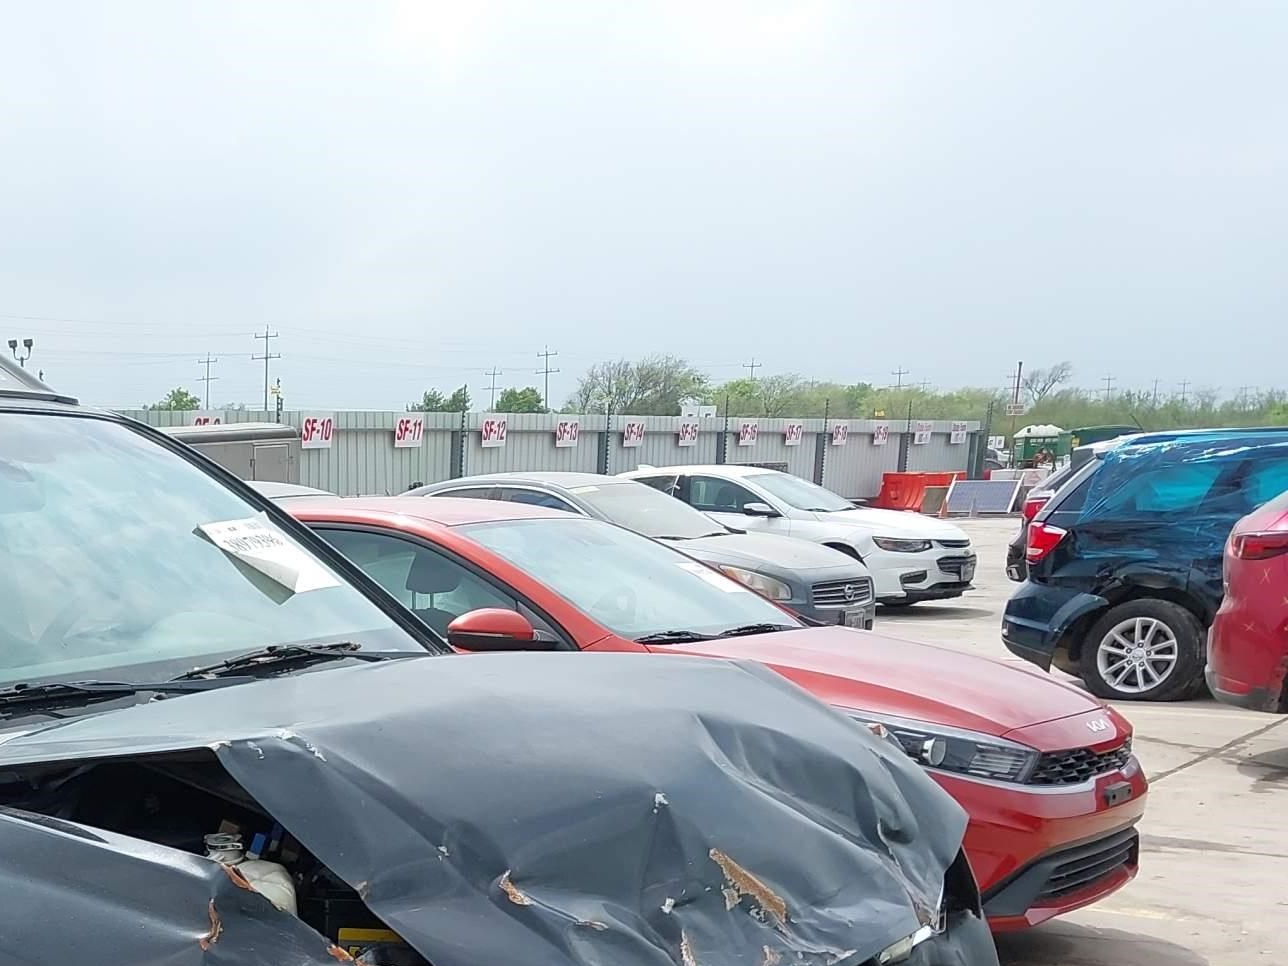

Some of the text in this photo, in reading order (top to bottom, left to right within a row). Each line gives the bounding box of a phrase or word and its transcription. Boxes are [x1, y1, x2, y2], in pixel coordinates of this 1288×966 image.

[303, 418, 333, 441] SF-10
[396, 418, 423, 441] SF-11
[482, 420, 506, 441] SF-12
[557, 422, 579, 440] SF-13
[624, 423, 644, 440] SF-14
[679, 423, 698, 440] SF-15
[740, 423, 758, 440] SF-16
[786, 424, 803, 440] SF-17
